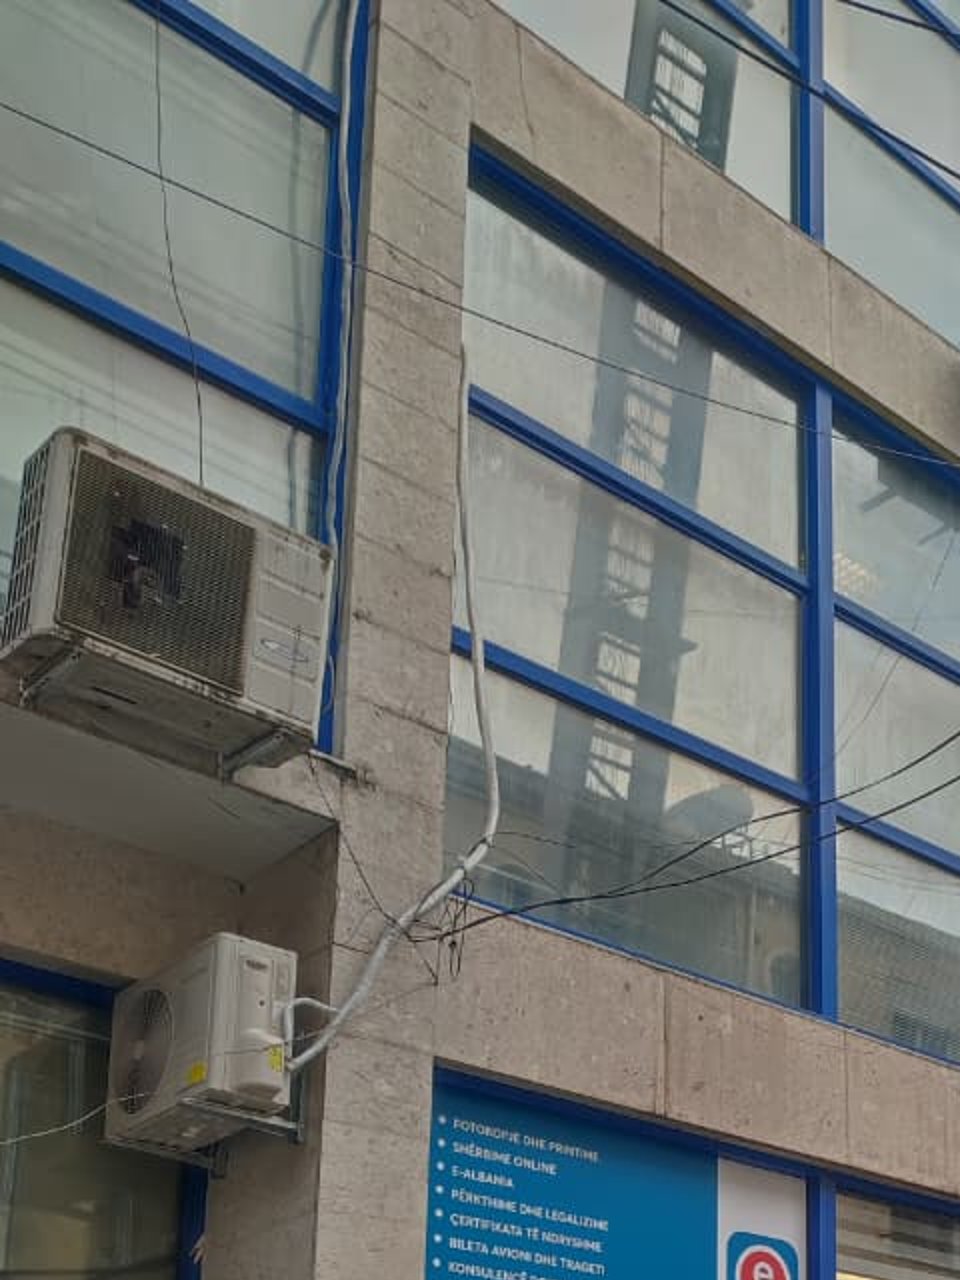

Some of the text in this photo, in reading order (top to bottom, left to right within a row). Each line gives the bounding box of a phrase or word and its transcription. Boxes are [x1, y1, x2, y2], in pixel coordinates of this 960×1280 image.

[523, 1136, 547, 1151] DHE
[514, 1156, 557, 1175] ONLINE
[451, 1165, 514, 1188] E-ALBANIA
[519, 1203, 544, 1219] DHE
[449, 1237, 489, 1256] BILETA
[534, 1253, 558, 1268] DHE
